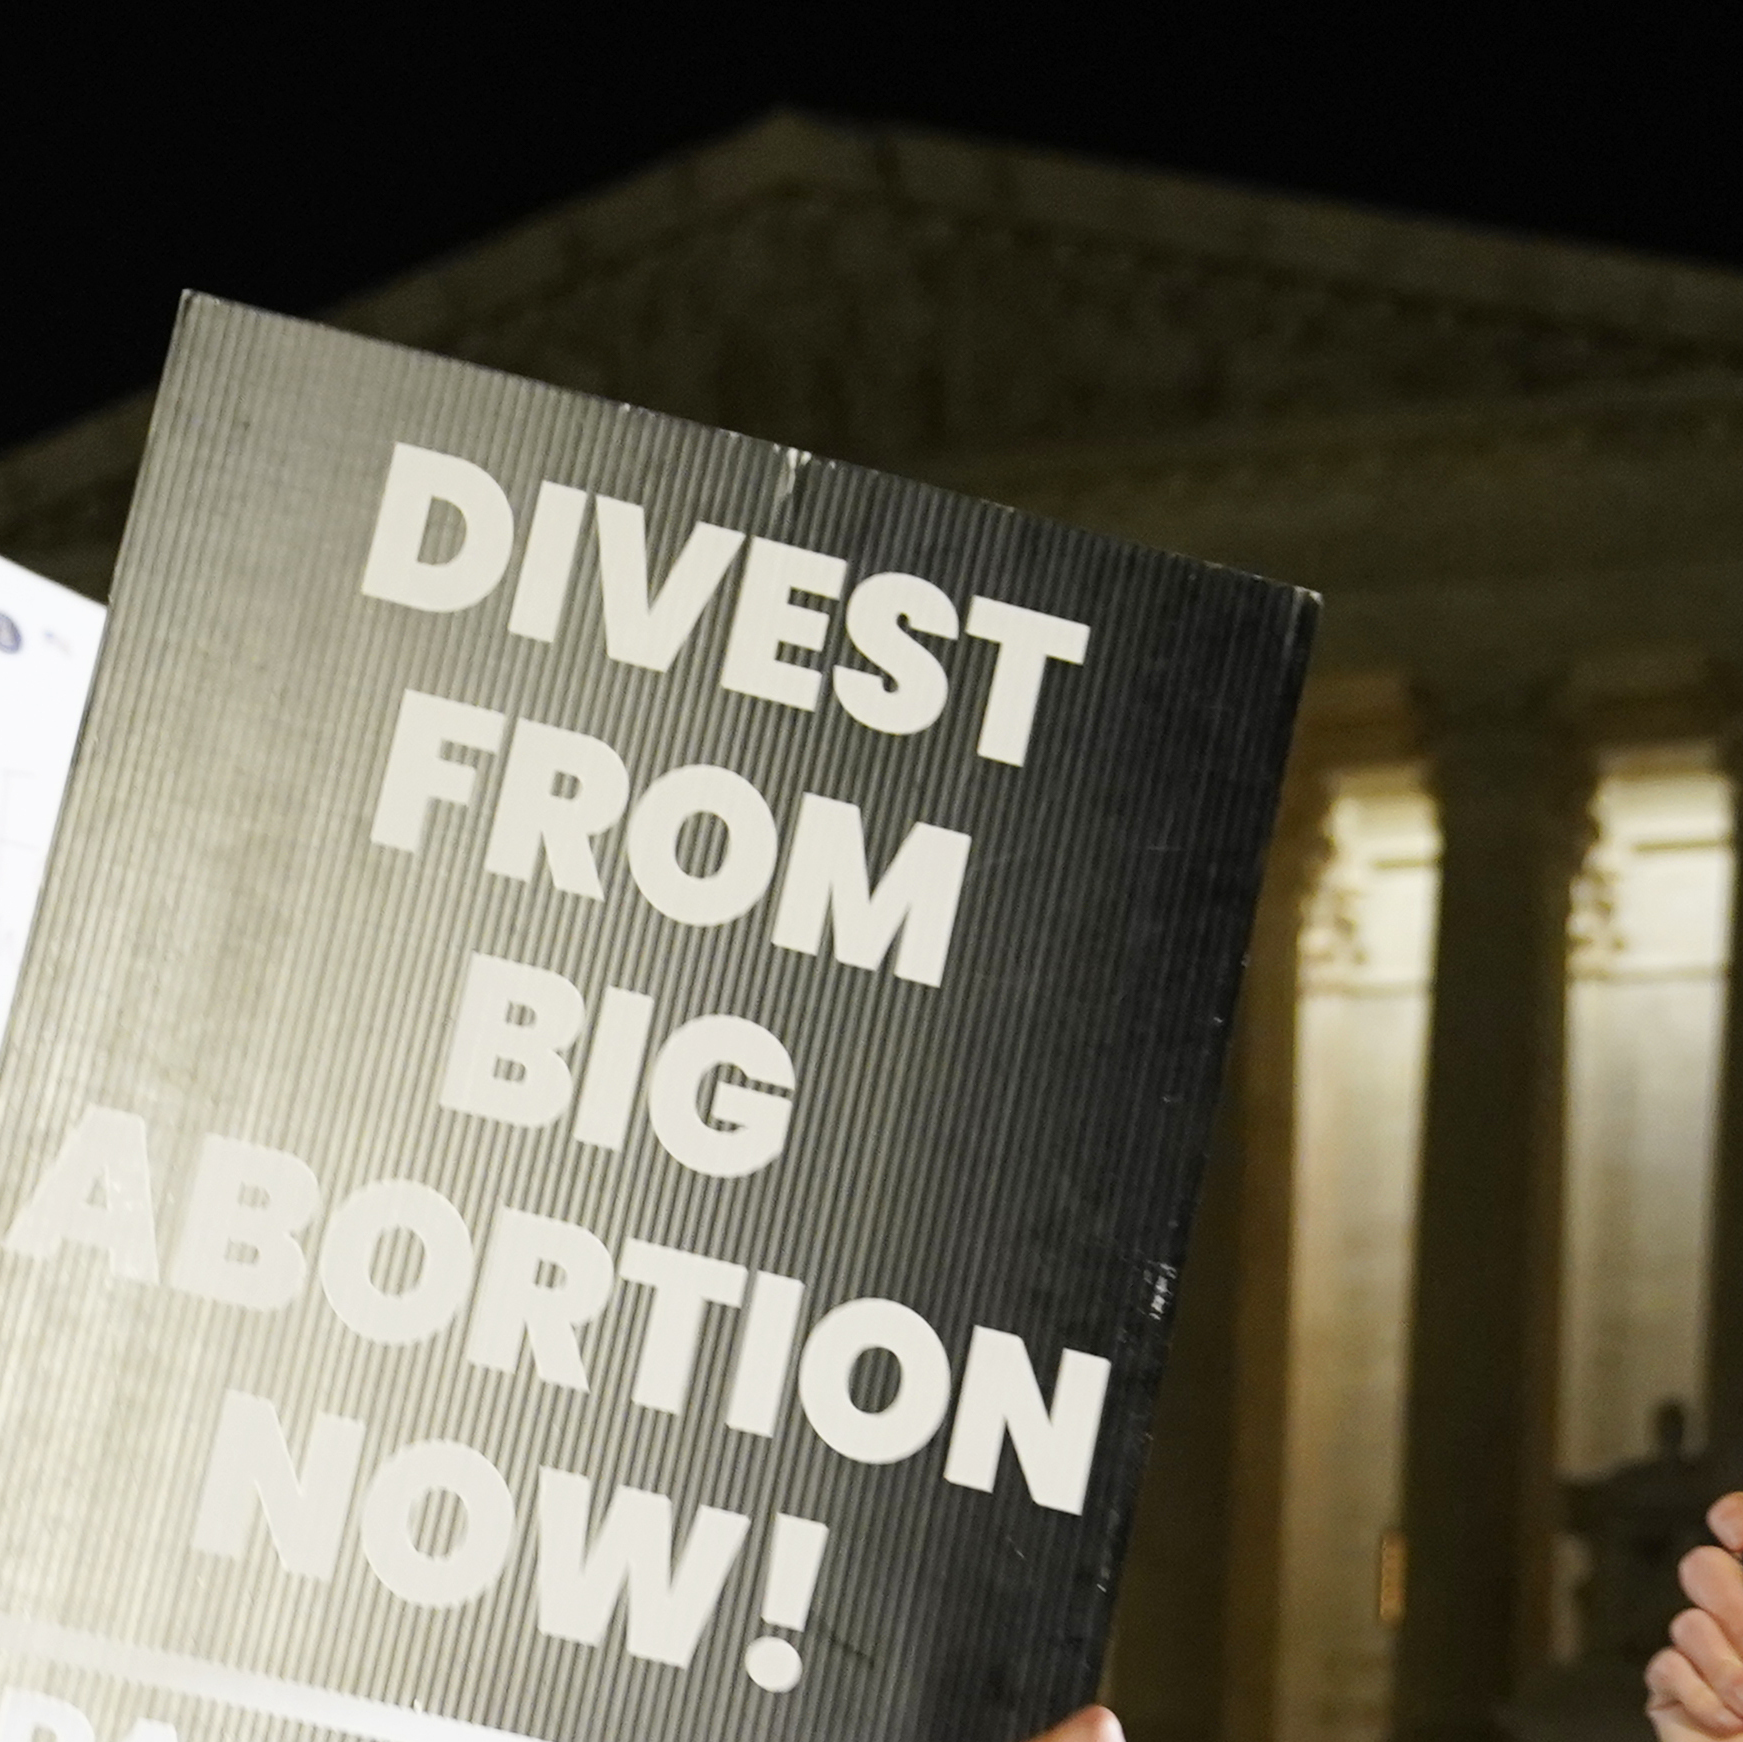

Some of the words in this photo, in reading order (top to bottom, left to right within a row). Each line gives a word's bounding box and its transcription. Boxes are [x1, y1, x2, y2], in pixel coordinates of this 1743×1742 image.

[361, 441, 1090, 767] DIVEST
[370, 688, 972, 988] FROM
[439, 952, 796, 1178] BIG
[2, 1102, 1112, 1516] ABORTION
[192, 1388, 829, 1692] NOW!
